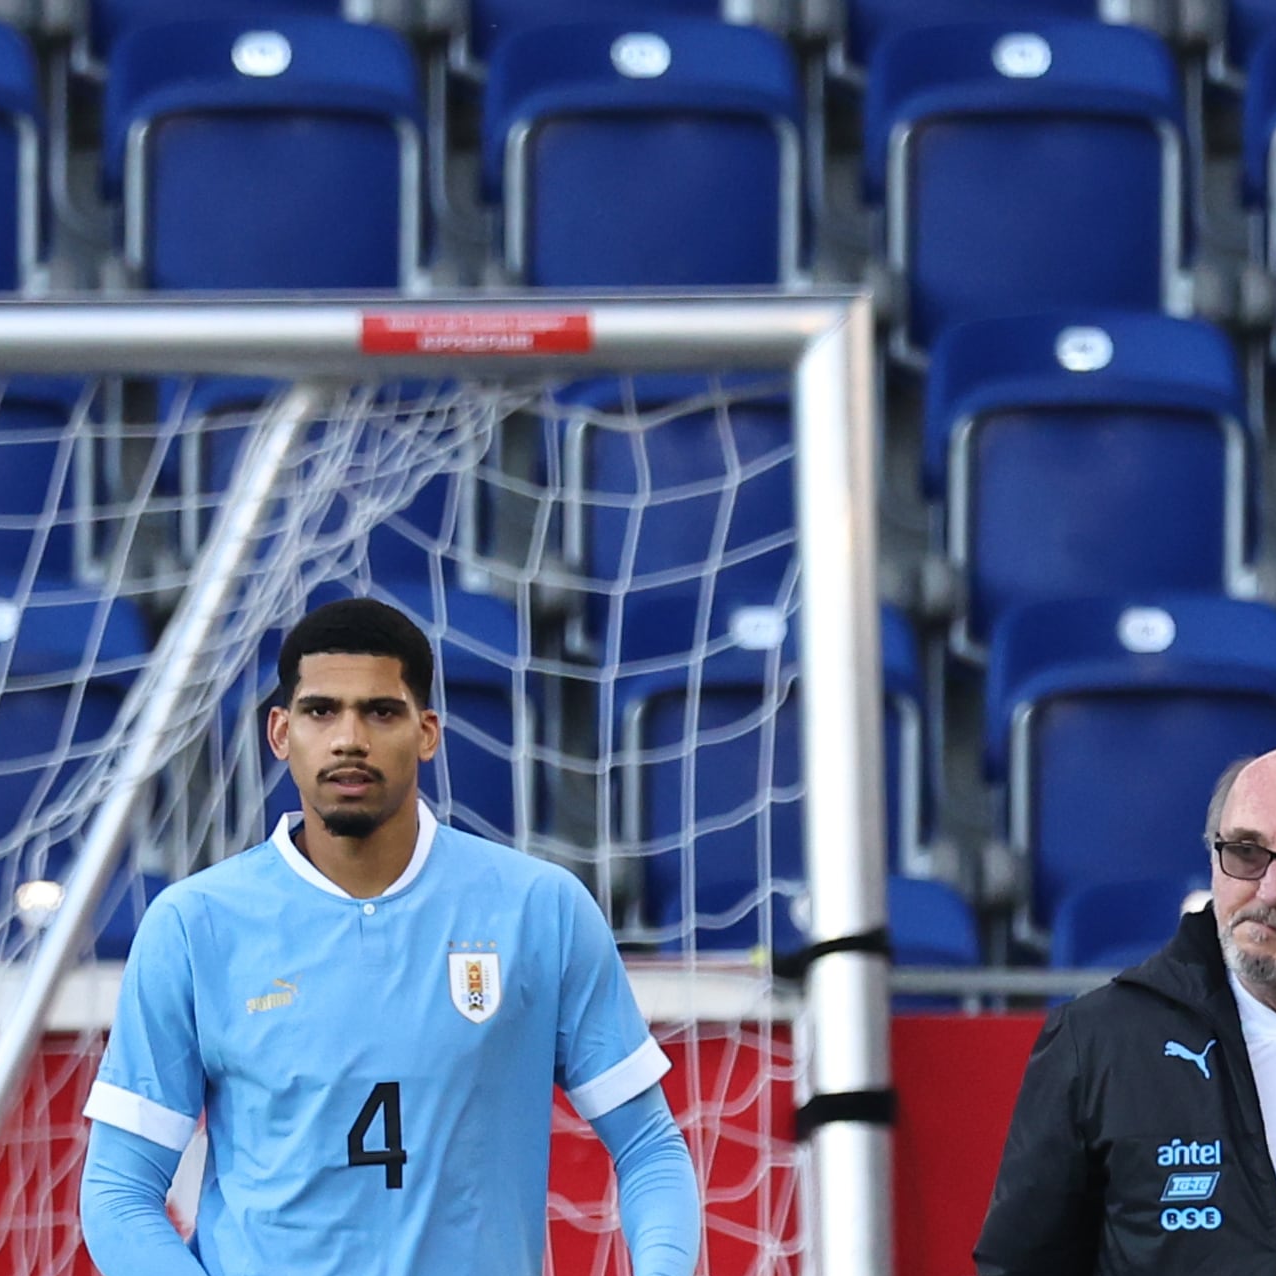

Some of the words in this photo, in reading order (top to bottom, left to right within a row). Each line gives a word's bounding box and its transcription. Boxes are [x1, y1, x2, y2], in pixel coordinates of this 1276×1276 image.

[347, 1081, 407, 1189] 4
[1157, 1139, 1221, 1166] antel
[1165, 1209, 1216, 1227] BSE
